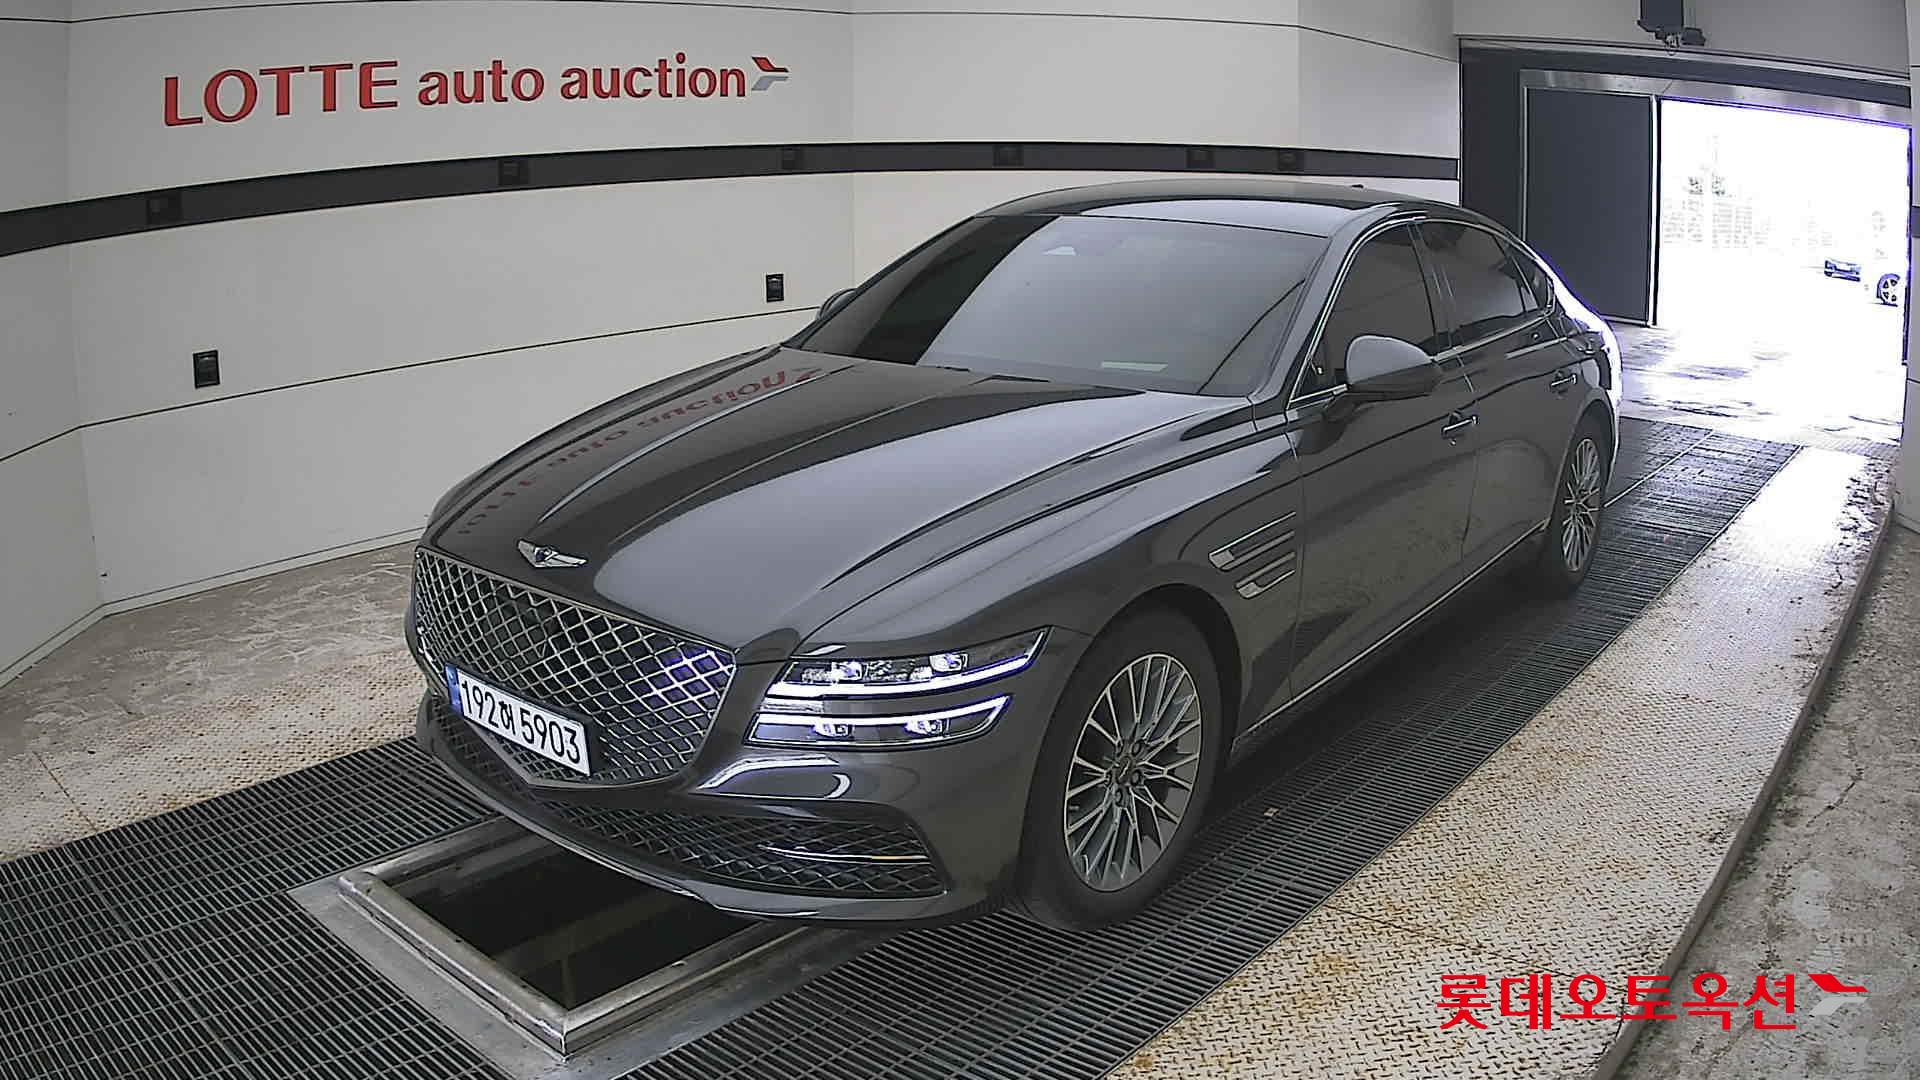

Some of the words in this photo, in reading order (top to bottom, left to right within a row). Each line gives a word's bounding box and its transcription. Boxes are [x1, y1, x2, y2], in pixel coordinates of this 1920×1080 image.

[163, 60, 399, 127] LOTTE
[417, 59, 545, 106] auto
[559, 52, 748, 100] auction
[520, 707, 580, 765] 5903
